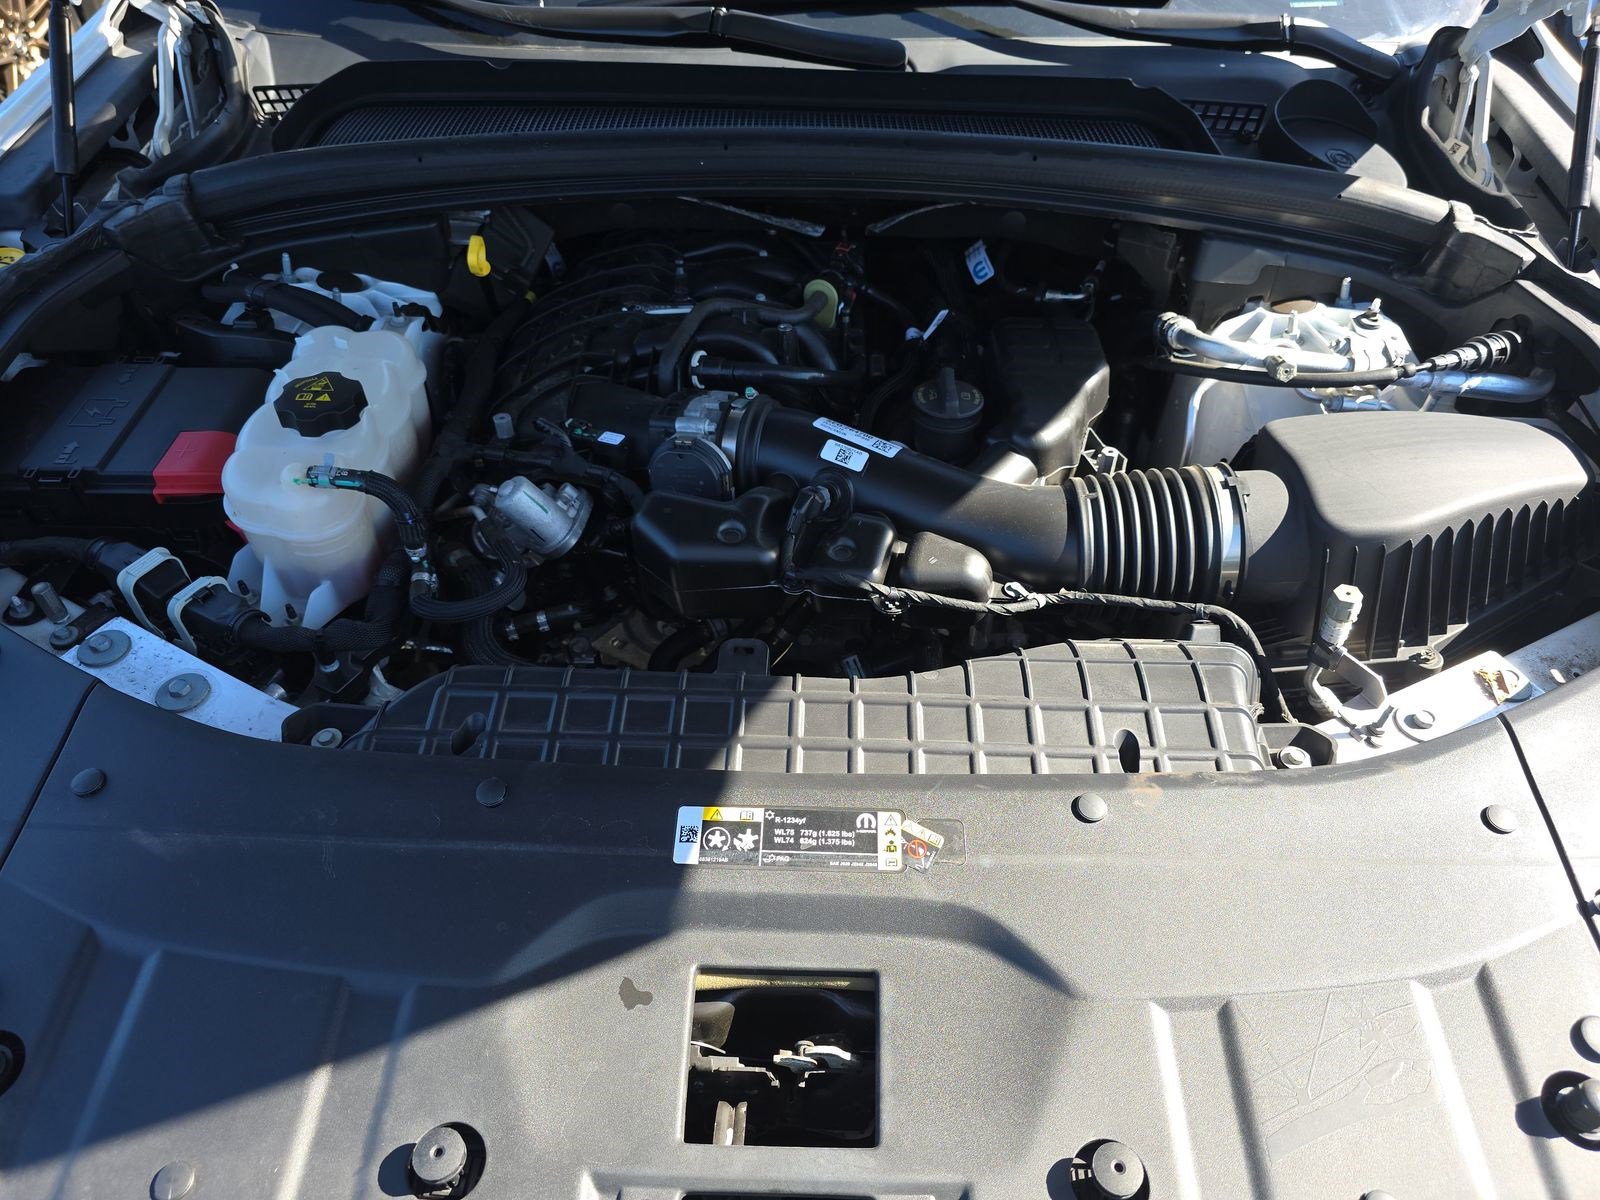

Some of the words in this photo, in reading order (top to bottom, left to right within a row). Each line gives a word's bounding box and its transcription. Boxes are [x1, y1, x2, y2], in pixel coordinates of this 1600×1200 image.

[775, 816, 807, 825] R-1234yf
[774, 828, 795, 836] WL75
[799, 829, 818, 838] 737g
[818, 830, 841, 838] (1.625
[841, 830, 856, 838] lbs)
[773, 836, 795, 844] WL74
[799, 837, 818, 846] 624g
[818, 838, 841, 846] (1.375
[841, 839, 856, 847] lbs)
